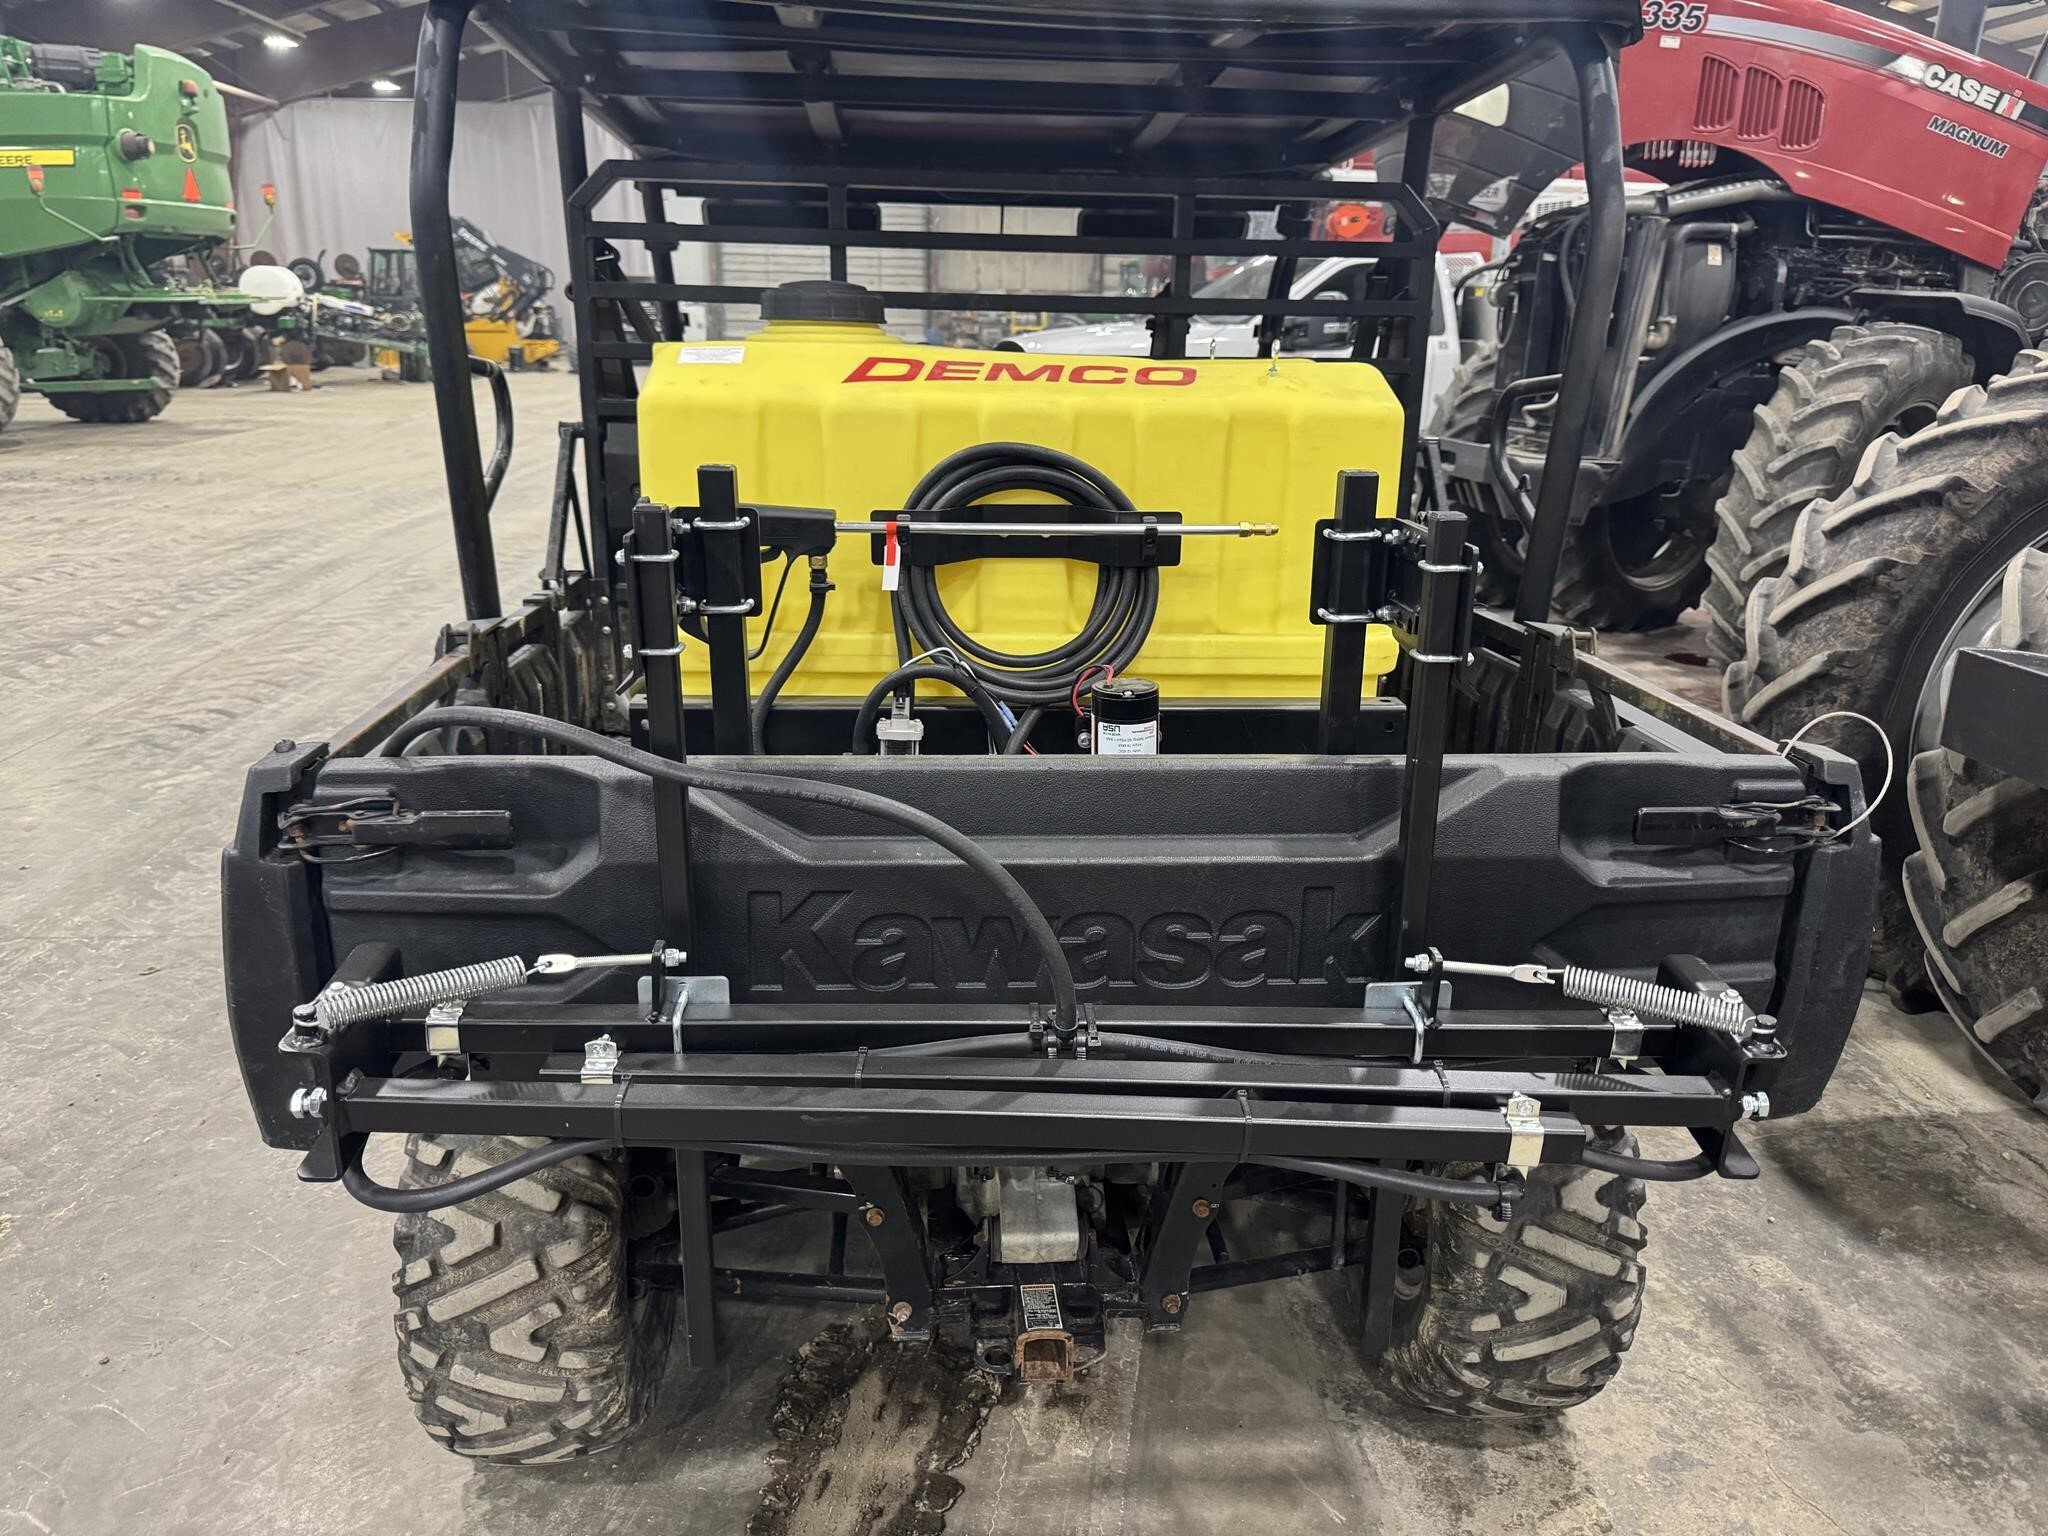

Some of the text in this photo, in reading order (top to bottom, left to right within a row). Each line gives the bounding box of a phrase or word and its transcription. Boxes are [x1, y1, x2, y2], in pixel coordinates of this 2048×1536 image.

[1642, 0, 1708, 33] 335
[1923, 63, 2001, 111] CASE
[1928, 115, 2009, 158] MAGNUM
[841, 356, 1198, 386] DEMCO
[1102, 724, 1121, 733] USA
[746, 886, 1384, 993] Kawasak
